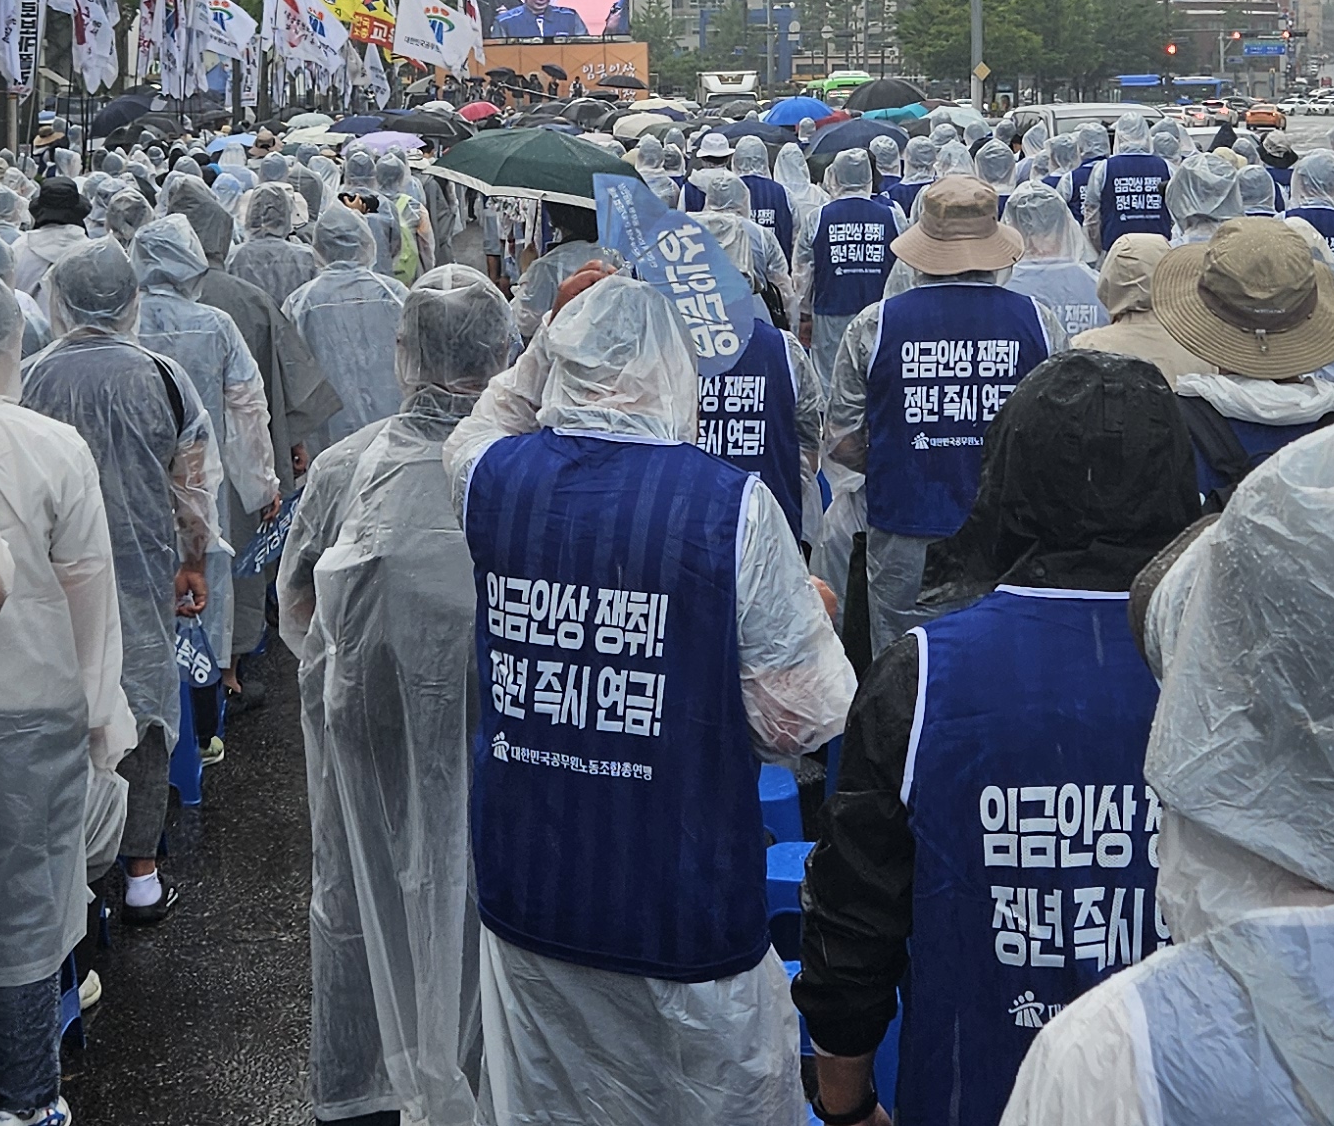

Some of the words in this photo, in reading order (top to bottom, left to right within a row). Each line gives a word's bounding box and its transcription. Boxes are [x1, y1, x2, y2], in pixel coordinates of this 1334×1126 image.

[1114, 177, 1143, 193] 임금인상
[1116, 195, 1130, 211] 정년
[828, 223, 863, 243] 임금인상
[864, 222, 885, 242] 쟁취!
[830, 245, 847, 264] 정년
[848, 244, 864, 263] 즉시
[865, 244, 885, 262] 연금!
[901, 340, 973, 380] 임금인상
[976, 340, 1020, 377] 쟁취!
[723, 374, 766, 414] 쟁취!
[903, 385, 940, 424] 정년
[942, 385, 977, 423] 즉시
[726, 419, 765, 456] 연금!
[486, 571, 590, 651] 임금인상
[594, 587, 669, 659] 쟁취!
[490, 649, 529, 720] 정년
[534, 660, 591, 730] 즉시
[596, 665, 666, 737] 연금!
[511, 744, 653, 781] 대한민국공무원노동조합총연맹
[979, 782, 1137, 868] 임금인상
[990, 885, 1065, 967] 정년
[1073, 886, 1145, 973] 즉시
